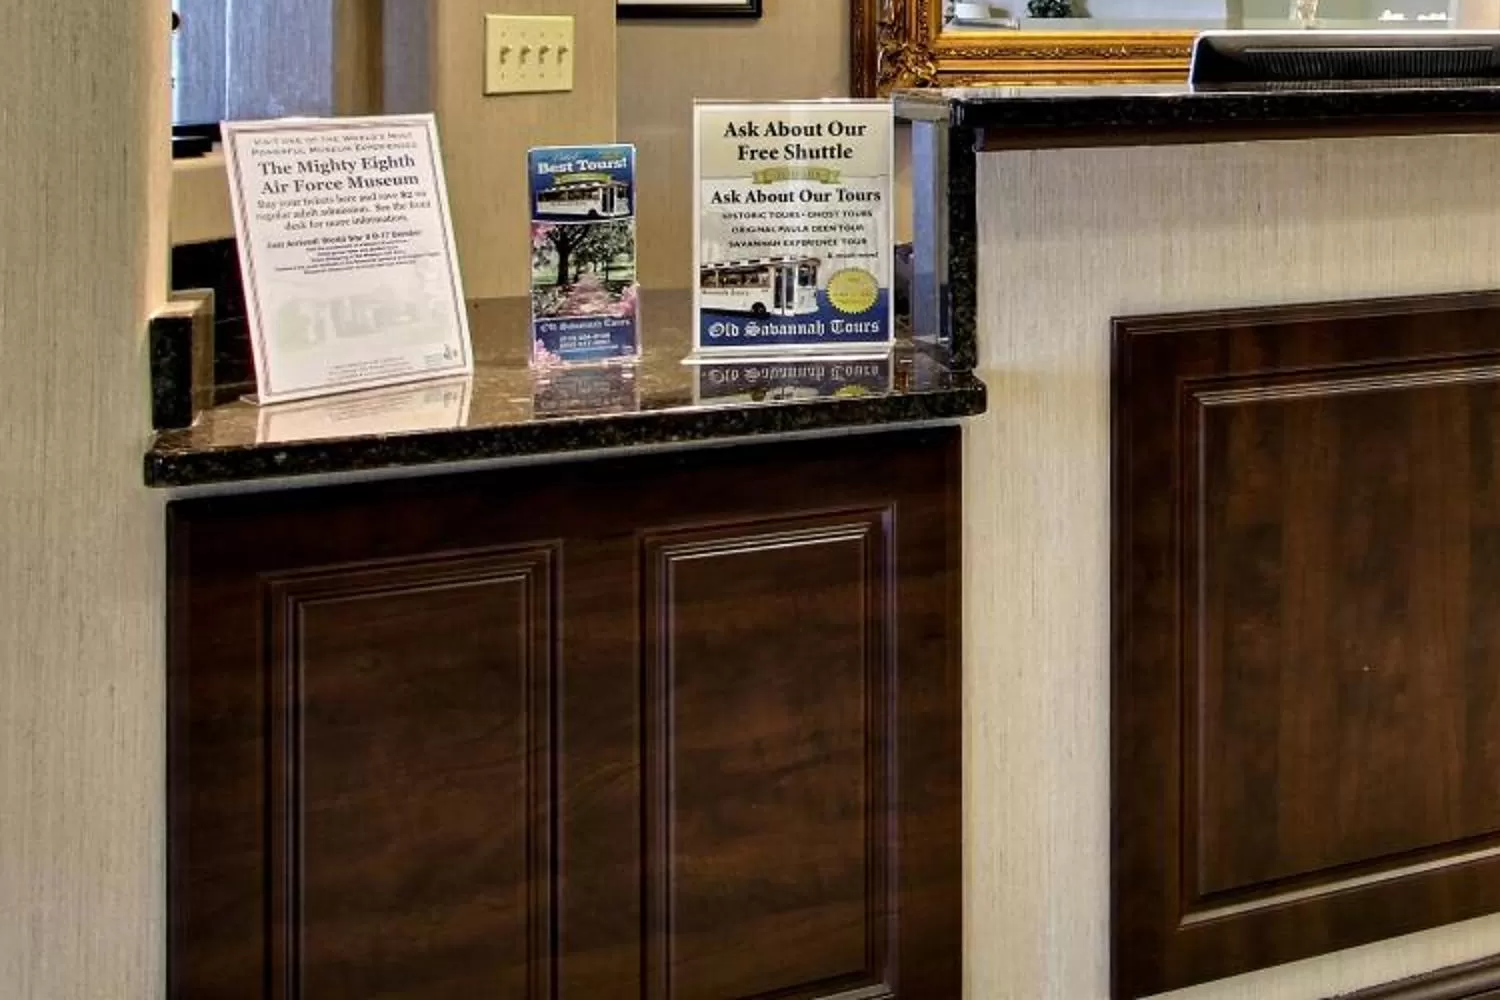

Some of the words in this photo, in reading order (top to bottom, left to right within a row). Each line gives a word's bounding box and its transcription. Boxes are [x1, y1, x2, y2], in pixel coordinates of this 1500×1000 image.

[723, 121, 760, 137] Ask
[764, 121, 823, 137] About
[827, 120, 868, 137] Our
[738, 145, 780, 161] Free
[783, 143, 854, 161] Shuttle
[257, 160, 293, 176] The
[297, 157, 357, 176] Mighty
[361, 153, 416, 173] Eighth
[537, 162, 574, 175] Best
[576, 157, 627, 171] Tours!
[260, 179, 289, 194] Air
[293, 178, 344, 193] Force
[347, 174, 420, 190] Museum
[711, 190, 741, 204] Ask
[745, 190, 795, 204] About
[799, 189, 833, 203] Our
[836, 188, 881, 202] Tours
[722, 212, 767, 220] HISTORIC
[769, 211, 800, 219] TOURS
[806, 210, 840, 218] GHOST
[778, 225, 809, 233] PAULA
[728, 240, 781, 248] SAVANNAH
[783, 238, 838, 247] EXPERIENCE
[841, 238, 868, 246] TOUR
[708, 321, 740, 338] Old
[744, 319, 825, 337] Savannah
[829, 318, 881, 334] Tours
